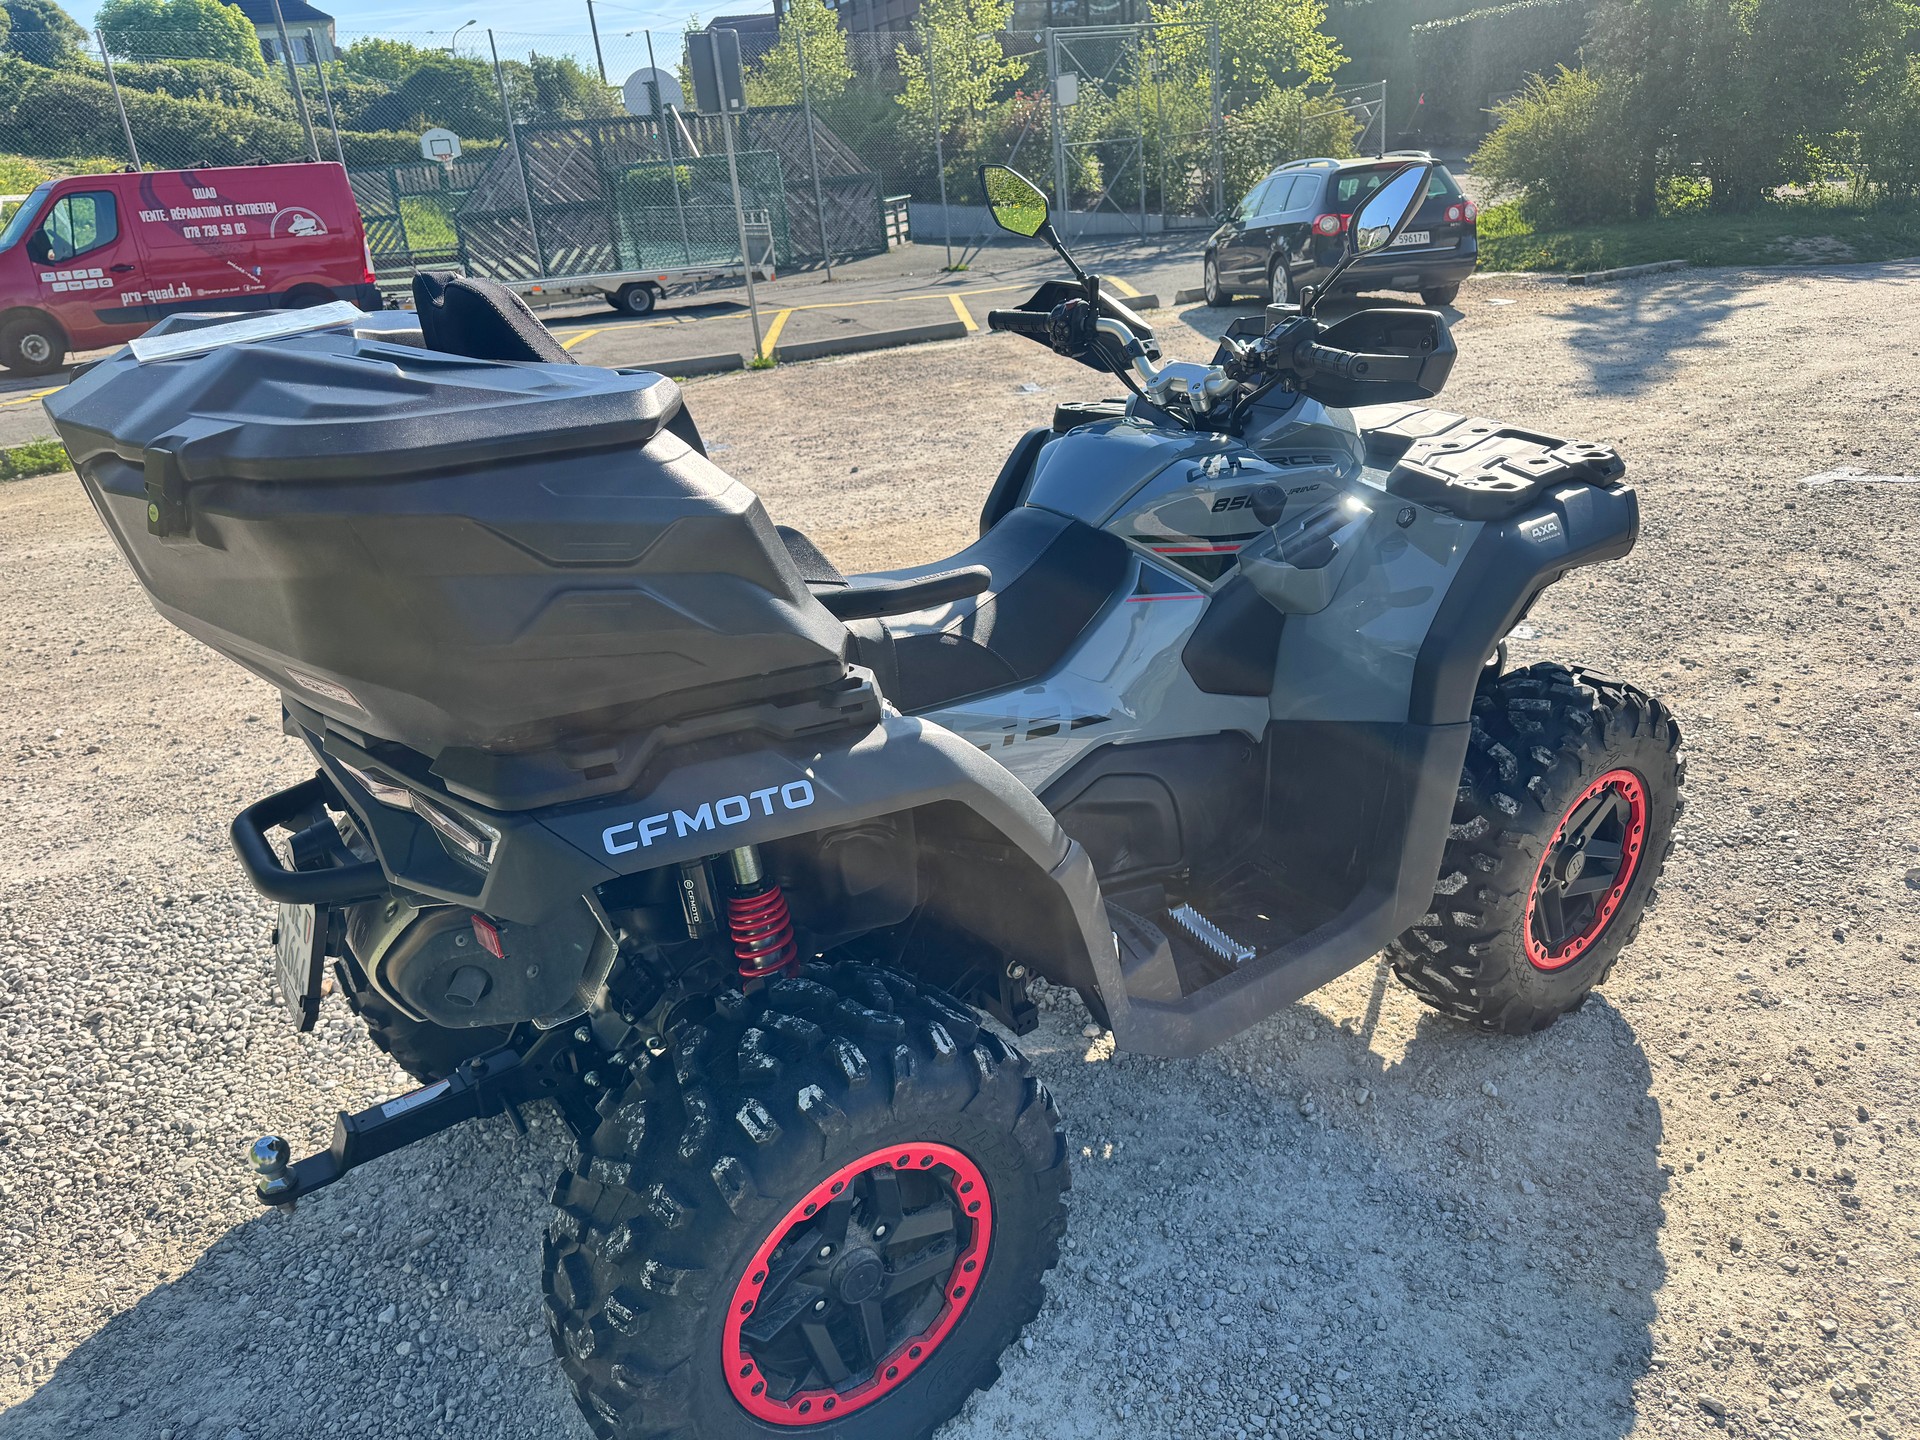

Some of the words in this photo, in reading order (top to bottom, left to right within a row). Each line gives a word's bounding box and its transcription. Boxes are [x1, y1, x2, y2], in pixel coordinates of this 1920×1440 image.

[192, 187, 217, 200] QUAD
[139, 208, 169, 223] VENTE,
[171, 204, 222, 221] RÉPARATION
[224, 205, 234, 217] ET
[236, 202, 278, 216] ENTRETIEN
[183, 226, 202, 239] 078
[202, 224, 219, 238] 738
[221, 223, 233, 236] 59
[235, 222, 247, 235] 03
[1399, 232, 1423, 244] 59617
[121, 282, 192, 306] pro-quad.ch
[1211, 495, 1252, 513] 85
[602, 779, 815, 855] CFMOTO
[688, 890, 700, 922] CFMOTO
